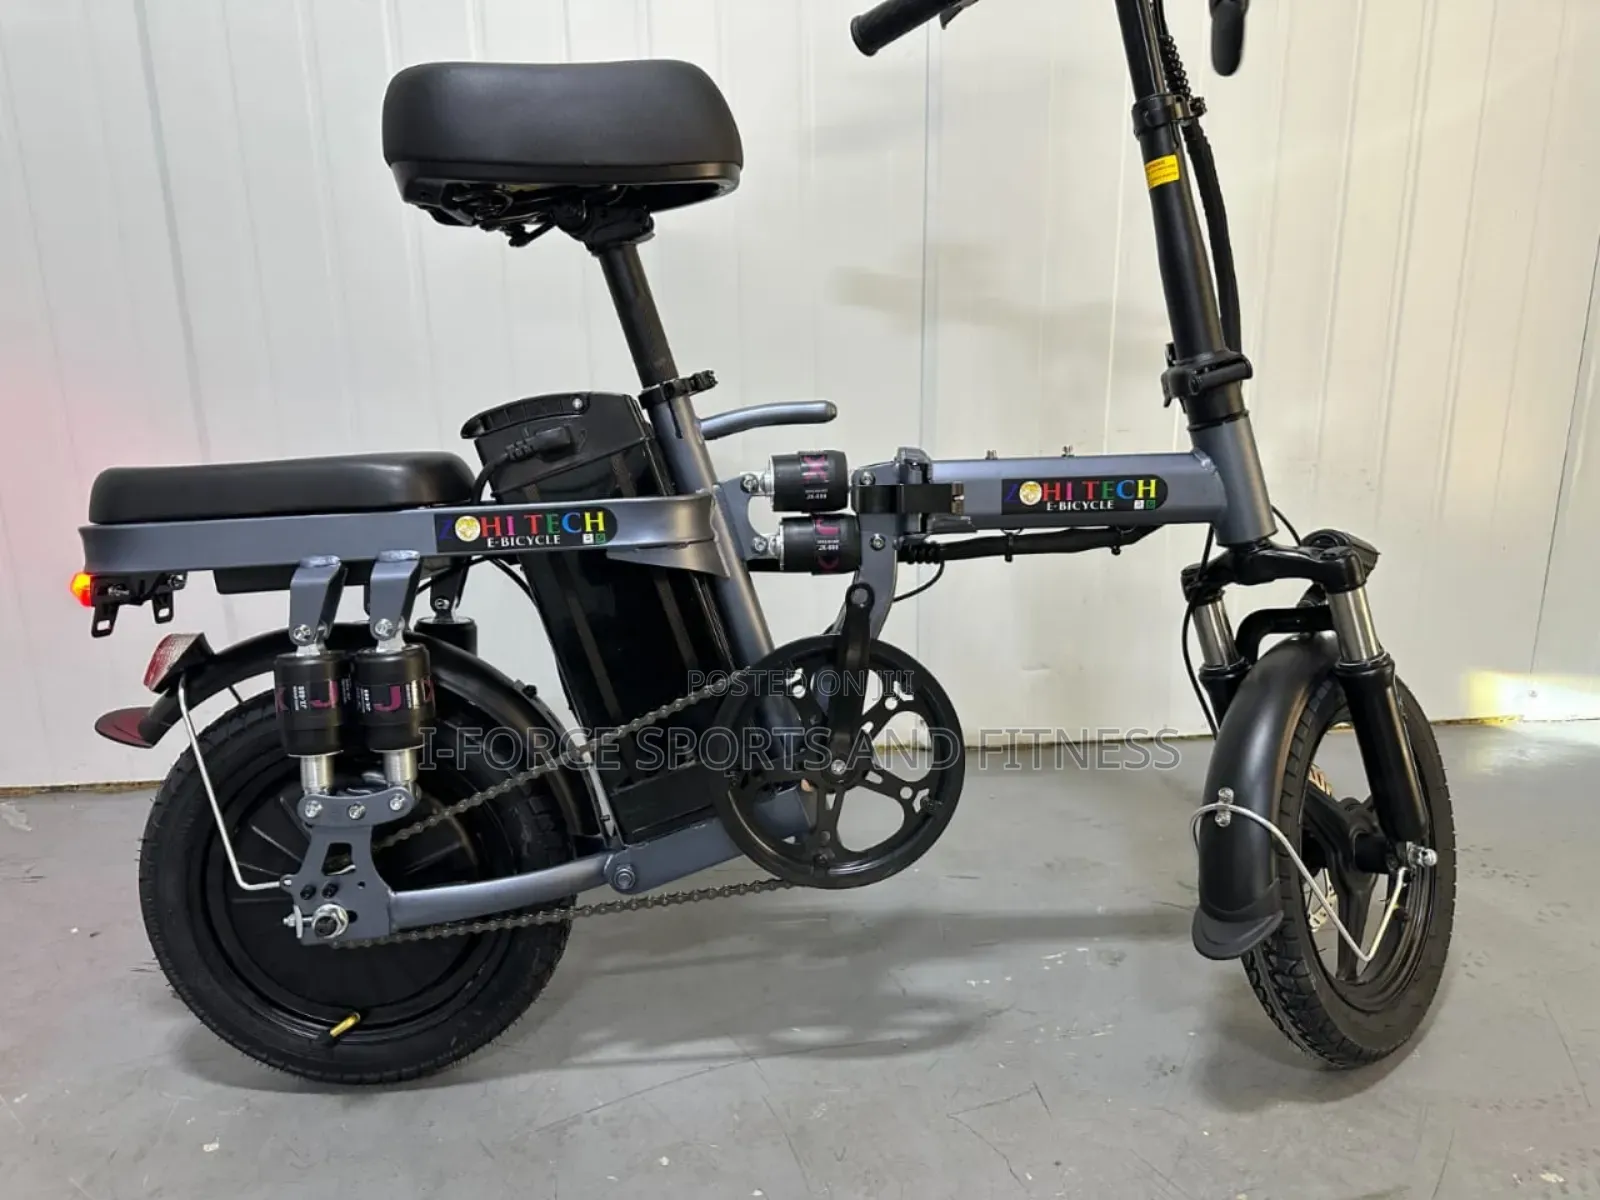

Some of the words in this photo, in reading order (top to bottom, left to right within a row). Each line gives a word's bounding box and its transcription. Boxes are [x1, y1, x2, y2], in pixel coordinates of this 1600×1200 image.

[1081, 479, 1157, 501] TECH
[1046, 500, 1115, 512] E-BICYCLE
[523, 511, 606, 536] TECH
[486, 534, 561, 549] E-BICYCLE
